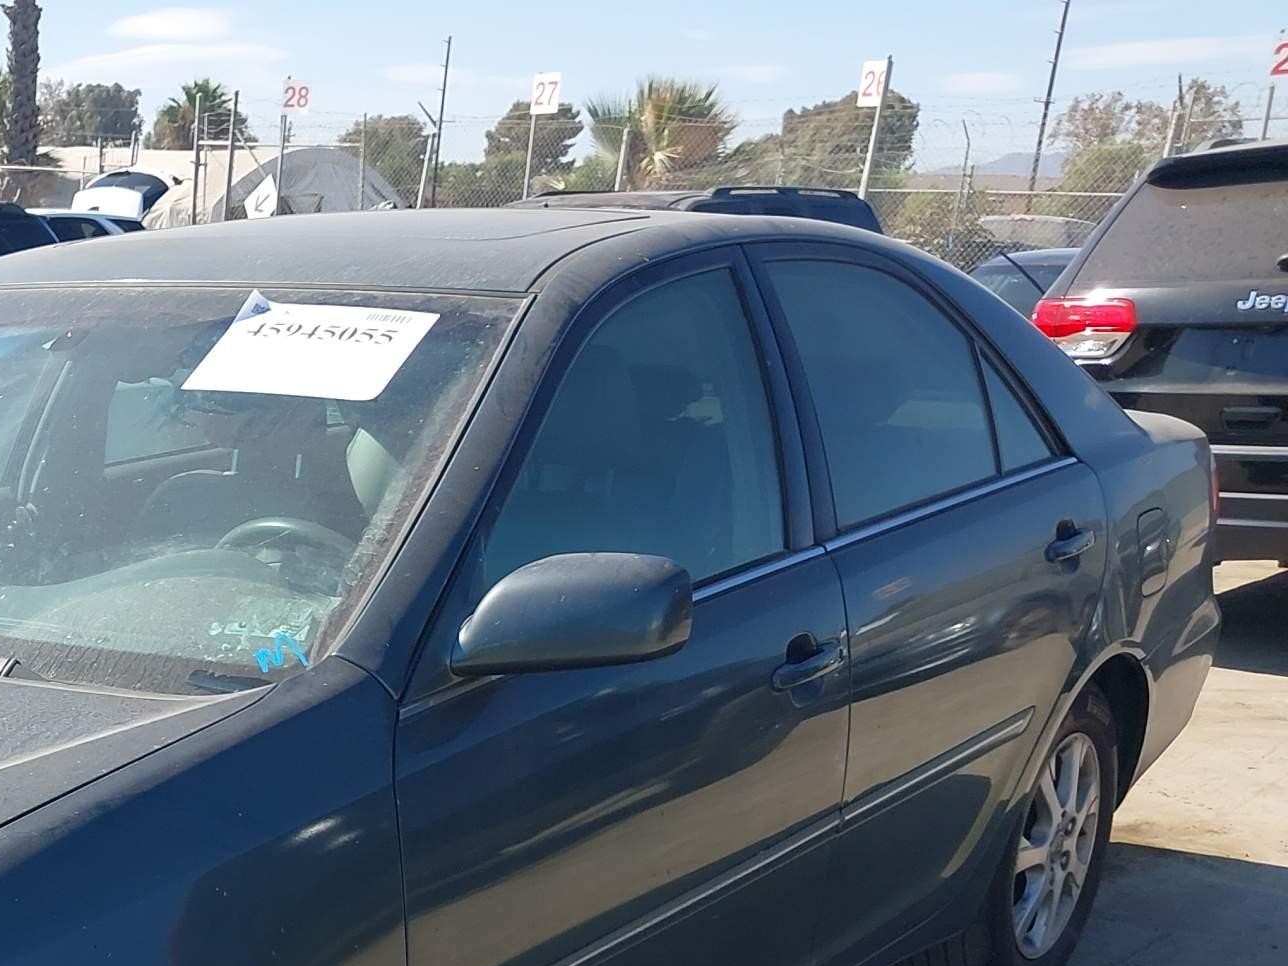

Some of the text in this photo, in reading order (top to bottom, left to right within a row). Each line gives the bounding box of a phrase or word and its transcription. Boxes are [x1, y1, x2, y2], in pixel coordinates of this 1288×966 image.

[283, 86, 310, 108] 28
[534, 81, 559, 106] 27
[1237, 291, 1288, 313] Jee
[247, 322, 401, 345] 45945055
